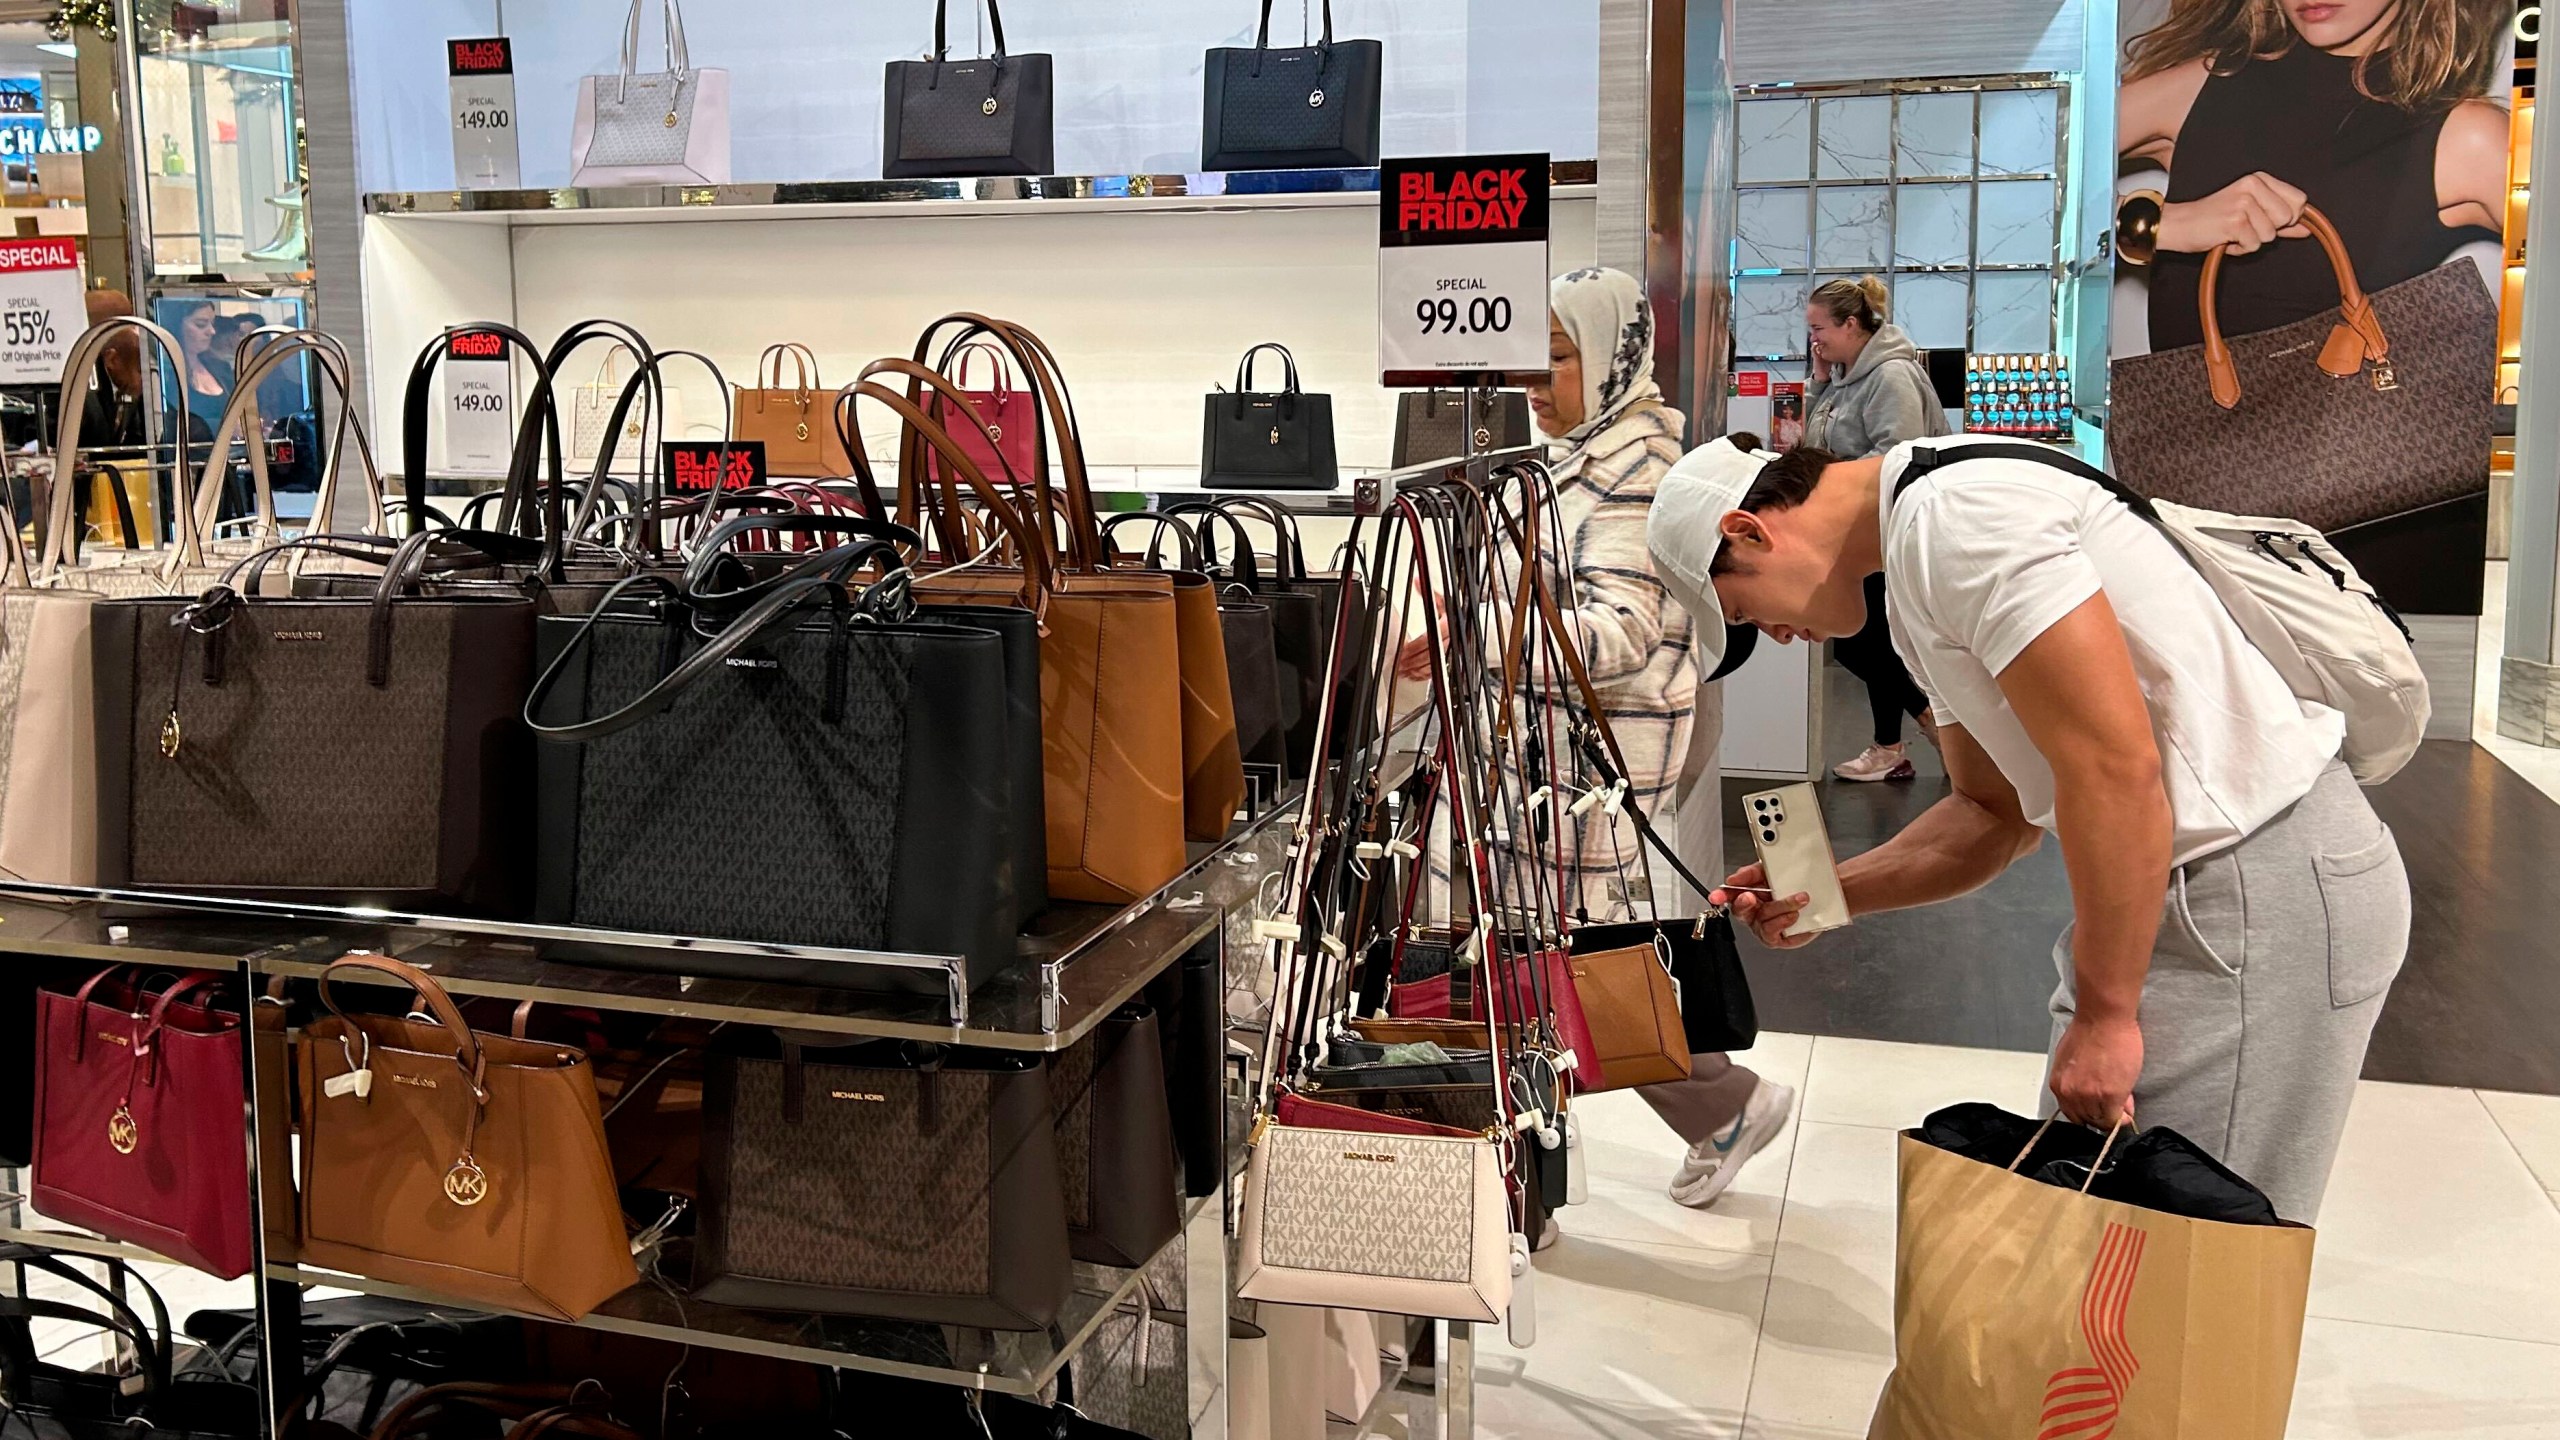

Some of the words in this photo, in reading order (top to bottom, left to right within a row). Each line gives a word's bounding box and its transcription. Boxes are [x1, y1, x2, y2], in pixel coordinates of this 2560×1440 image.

[455, 42, 503, 56] BLACK
[456, 54, 504, 69] FRIDAY
[468, 97, 496, 106] SPECIAL
[459, 110, 508, 129] 149.00
[0, 126, 103, 155] CHAMP
[1399, 169, 1528, 201] BLACK
[1399, 199, 1528, 231] FRIDAY
[0, 246, 70, 268] SPECIAL
[1436, 278, 1487, 291] SPECIAL
[7, 297, 39, 309] SPECIAL
[1416, 296, 1512, 335] 99.00
[4, 309, 55, 345] 55%
[452, 342, 501, 355] FRIDAY
[2, 352, 13, 362] Off
[14, 350, 42, 364] Original
[42, 350, 61, 361] Price
[462, 381, 490, 390] SPECIAL
[453, 394, 503, 411] 149.00
[832, 1090, 863, 1100] MICHAEL
[864, 1093, 885, 1102] KORS
[450, 1173, 481, 1195] MK
